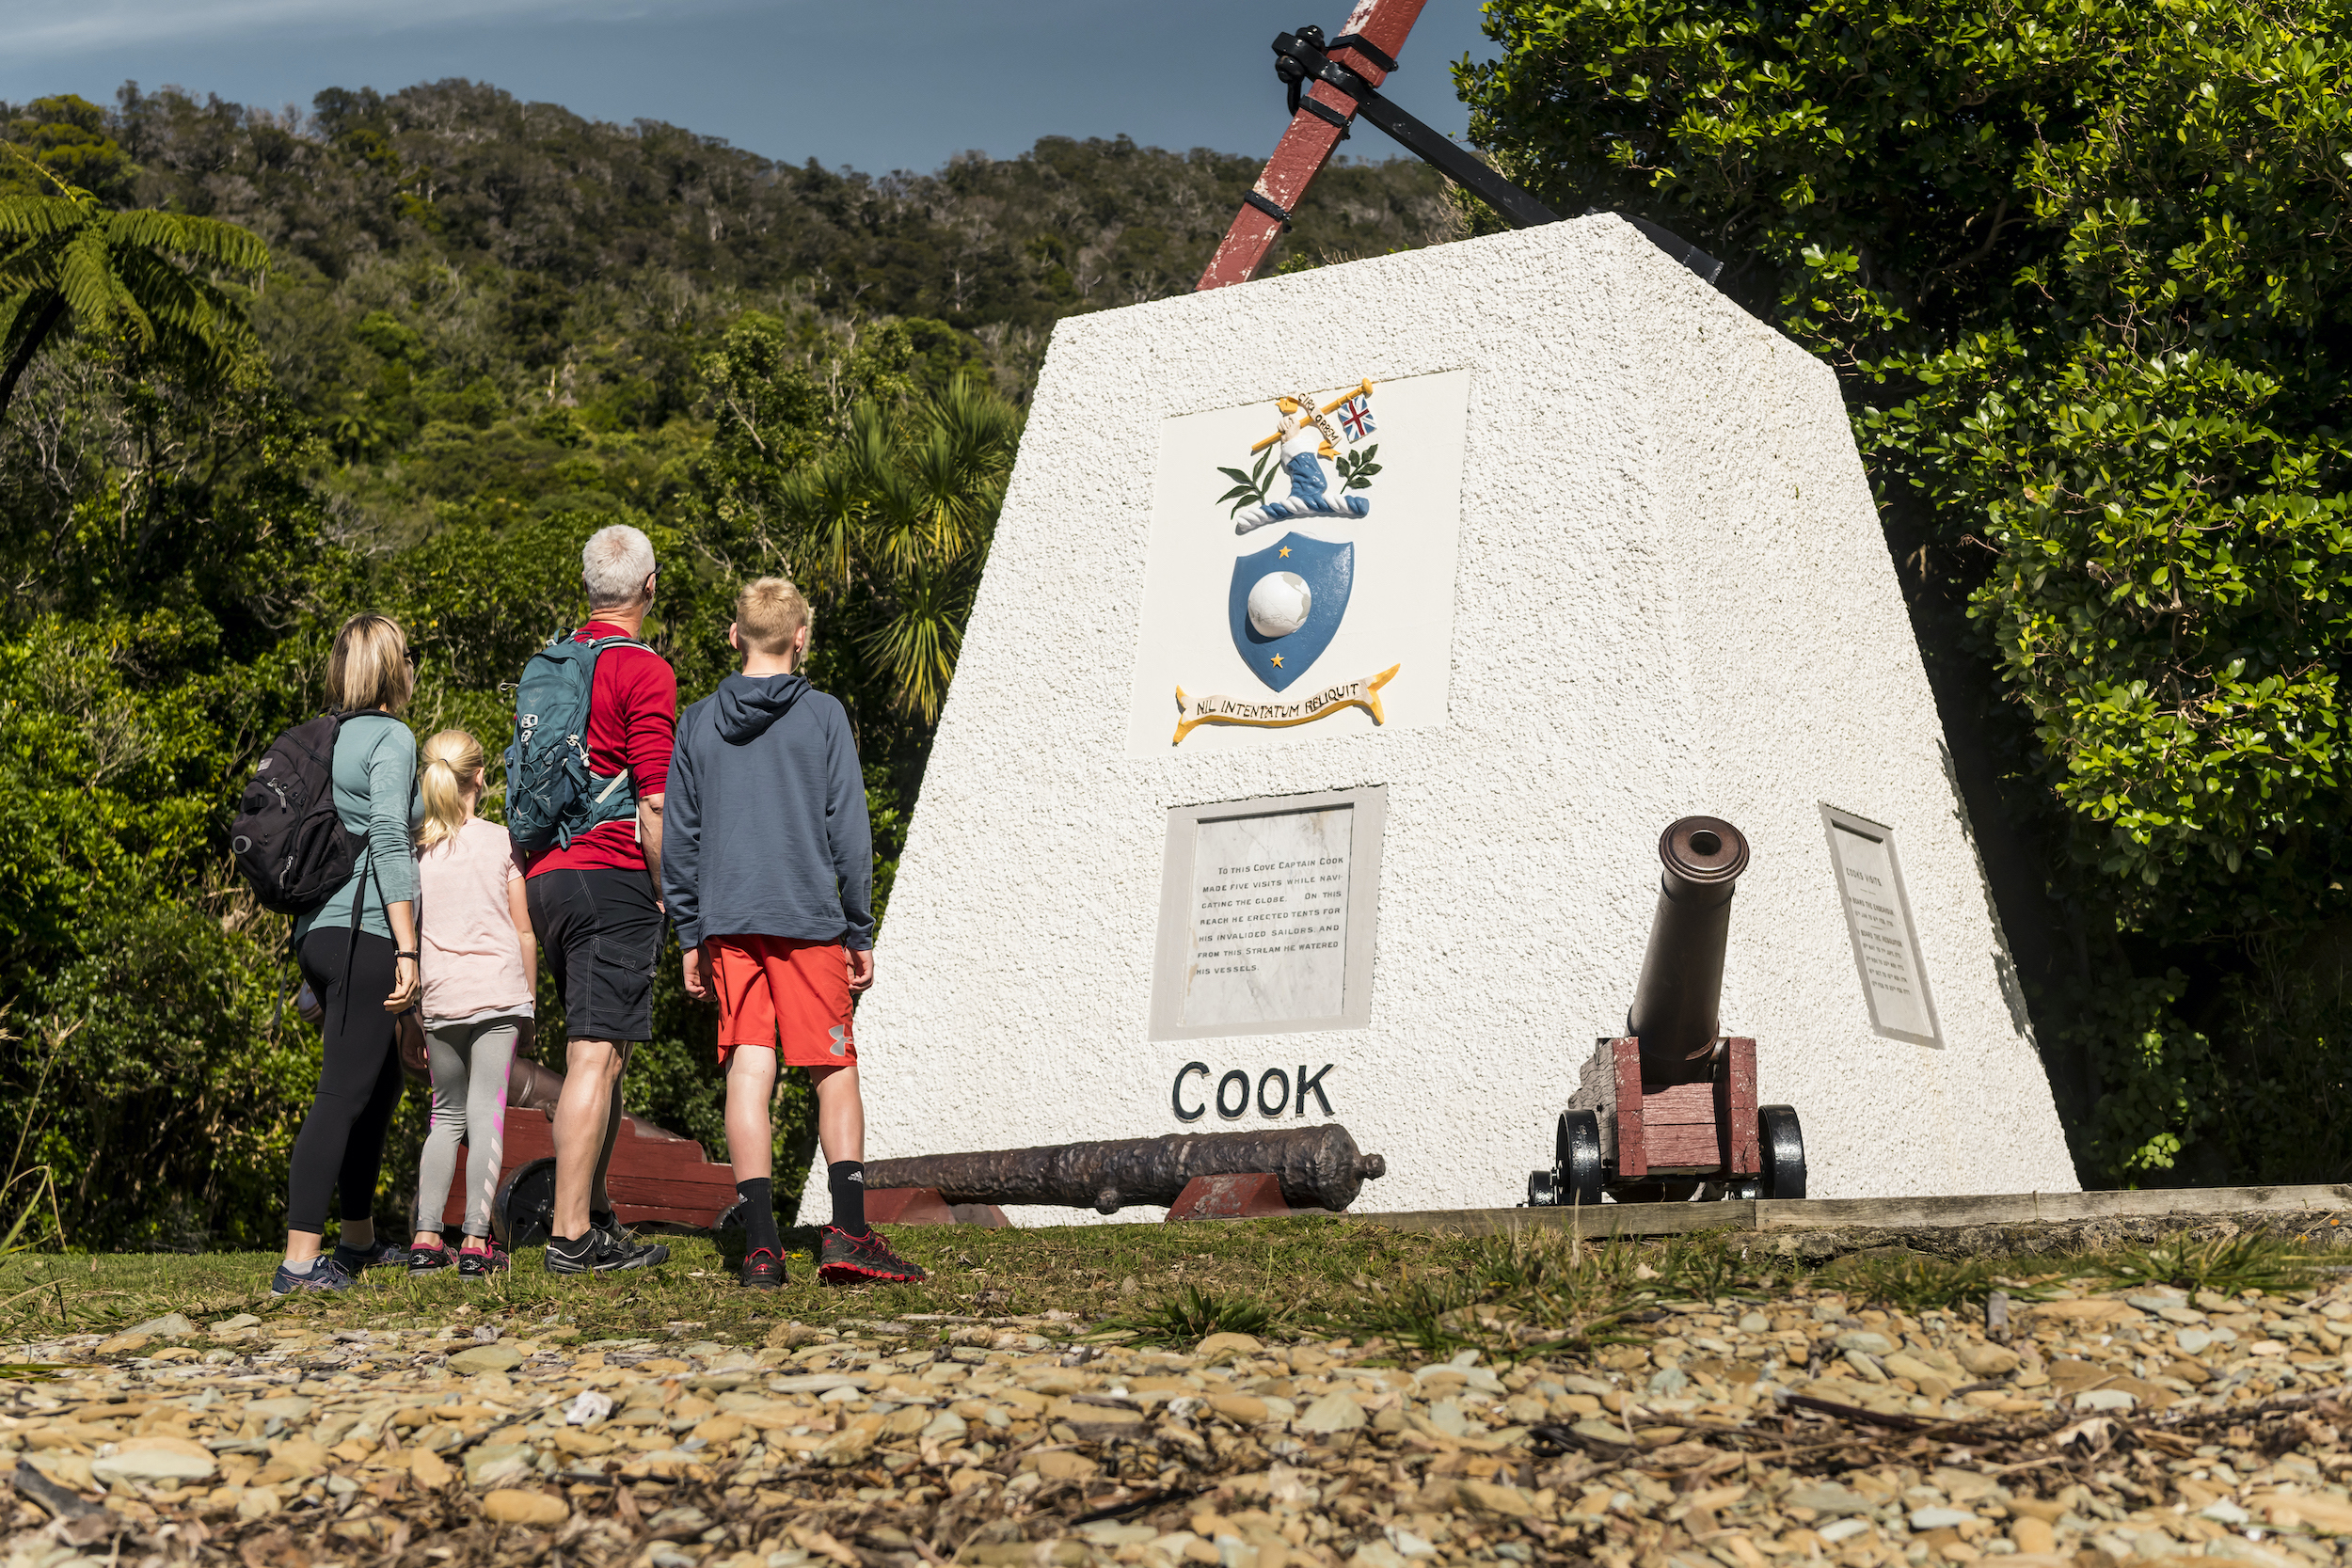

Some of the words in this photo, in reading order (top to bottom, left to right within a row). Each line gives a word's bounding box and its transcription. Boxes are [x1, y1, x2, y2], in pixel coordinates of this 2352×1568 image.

[1315, 414, 1339, 441] ORBEM
[1197, 699, 1216, 716] NIL
[1220, 700, 1300, 719] INTENTATUM
[1305, 683, 1359, 714] RELIQUIT
[1253, 863, 1276, 872] COVE
[1279, 860, 1316, 869] CAPTAIN
[1319, 857, 1343, 865] COOK
[1202, 884, 1227, 893] MADE
[1253, 879, 1282, 888] VISITS
[1286, 877, 1315, 885] WHILE
[1304, 892, 1317, 900] ON
[1248, 912, 1289, 922] ERECTED
[1292, 909, 1320, 918] TENTS
[1216, 930, 1266, 941] INVALIDED
[1298, 941, 1339, 950] WATERED
[1172, 1061, 1335, 1123] COOK
